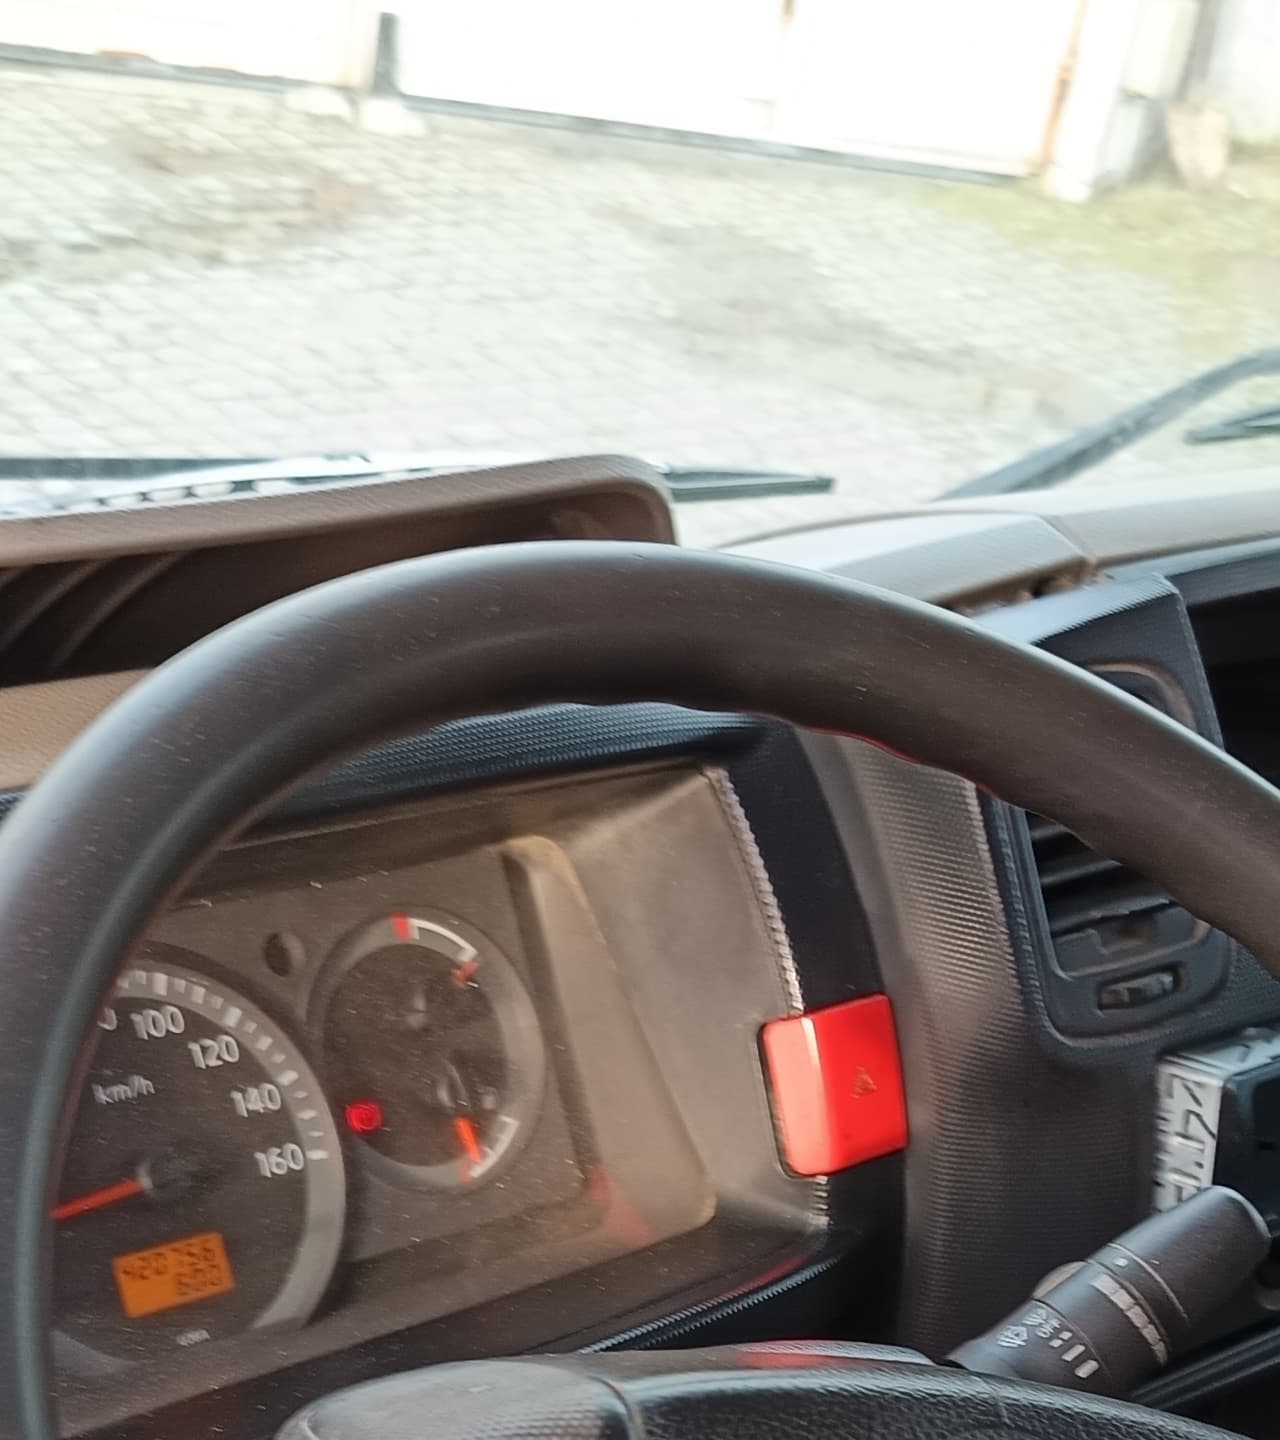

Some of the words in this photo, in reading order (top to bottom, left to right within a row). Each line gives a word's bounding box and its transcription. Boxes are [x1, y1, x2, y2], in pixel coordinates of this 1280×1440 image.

[130, 1005, 185, 1041] 100
[187, 1034, 240, 1069] 120
[230, 1082, 282, 1118] 140
[254, 1142, 305, 1178] 160
